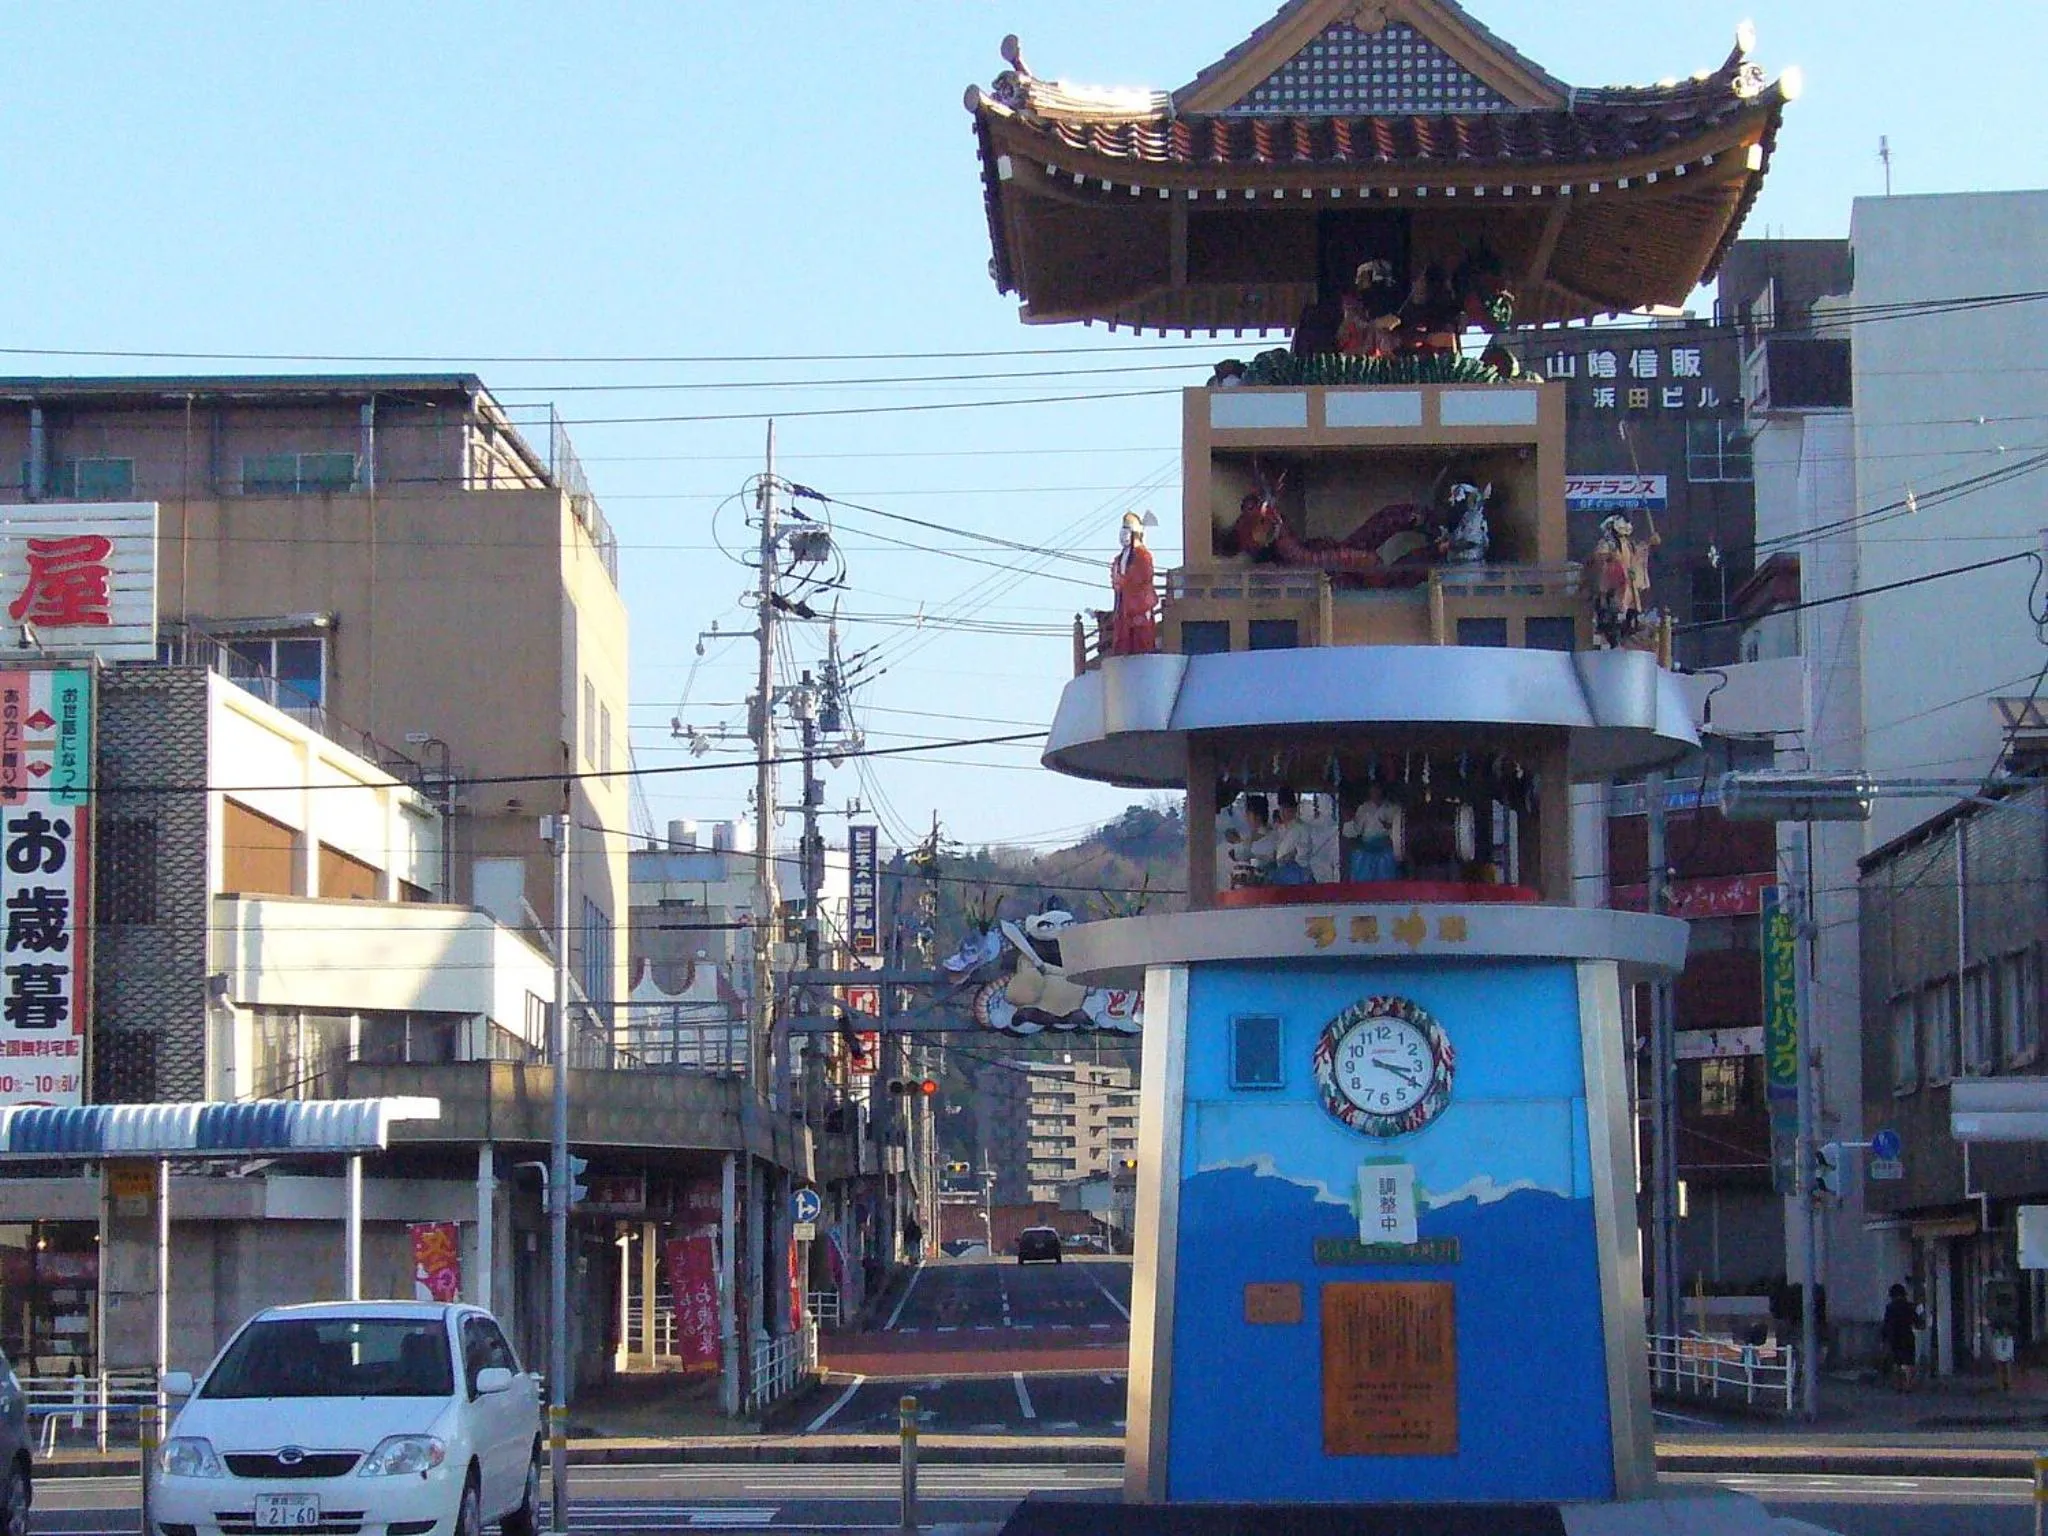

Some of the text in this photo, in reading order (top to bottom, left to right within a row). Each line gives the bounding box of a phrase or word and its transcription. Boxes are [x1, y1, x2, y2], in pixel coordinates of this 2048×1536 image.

[1546, 349, 1702, 379] 山陰信販
[1592, 386, 1721, 409] 浜田ビル
[1566, 480, 1656, 495] アデランス
[8, 535, 114, 627] 屋
[5, 811, 72, 1030] お歳暮
[1361, 1031, 1373, 1045] 11
[1375, 1026, 1391, 1040] 12
[1398, 1031, 1405, 1045] 1
[1349, 1045, 1365, 1058] 10
[1408, 1043, 1418, 1056] 2
[1345, 1060, 1355, 1074] 9
[1413, 1060, 1423, 1073] 3
[1351, 1077, 1361, 1090] 8
[1363, 1088, 1375, 1102] 7
[1379, 1092, 1390, 1106] 6
[1396, 1087, 1406, 1101] 5
[1379, 1177, 1397, 1232] 調整中
[270, 1507, 316, 1525] 21-60
